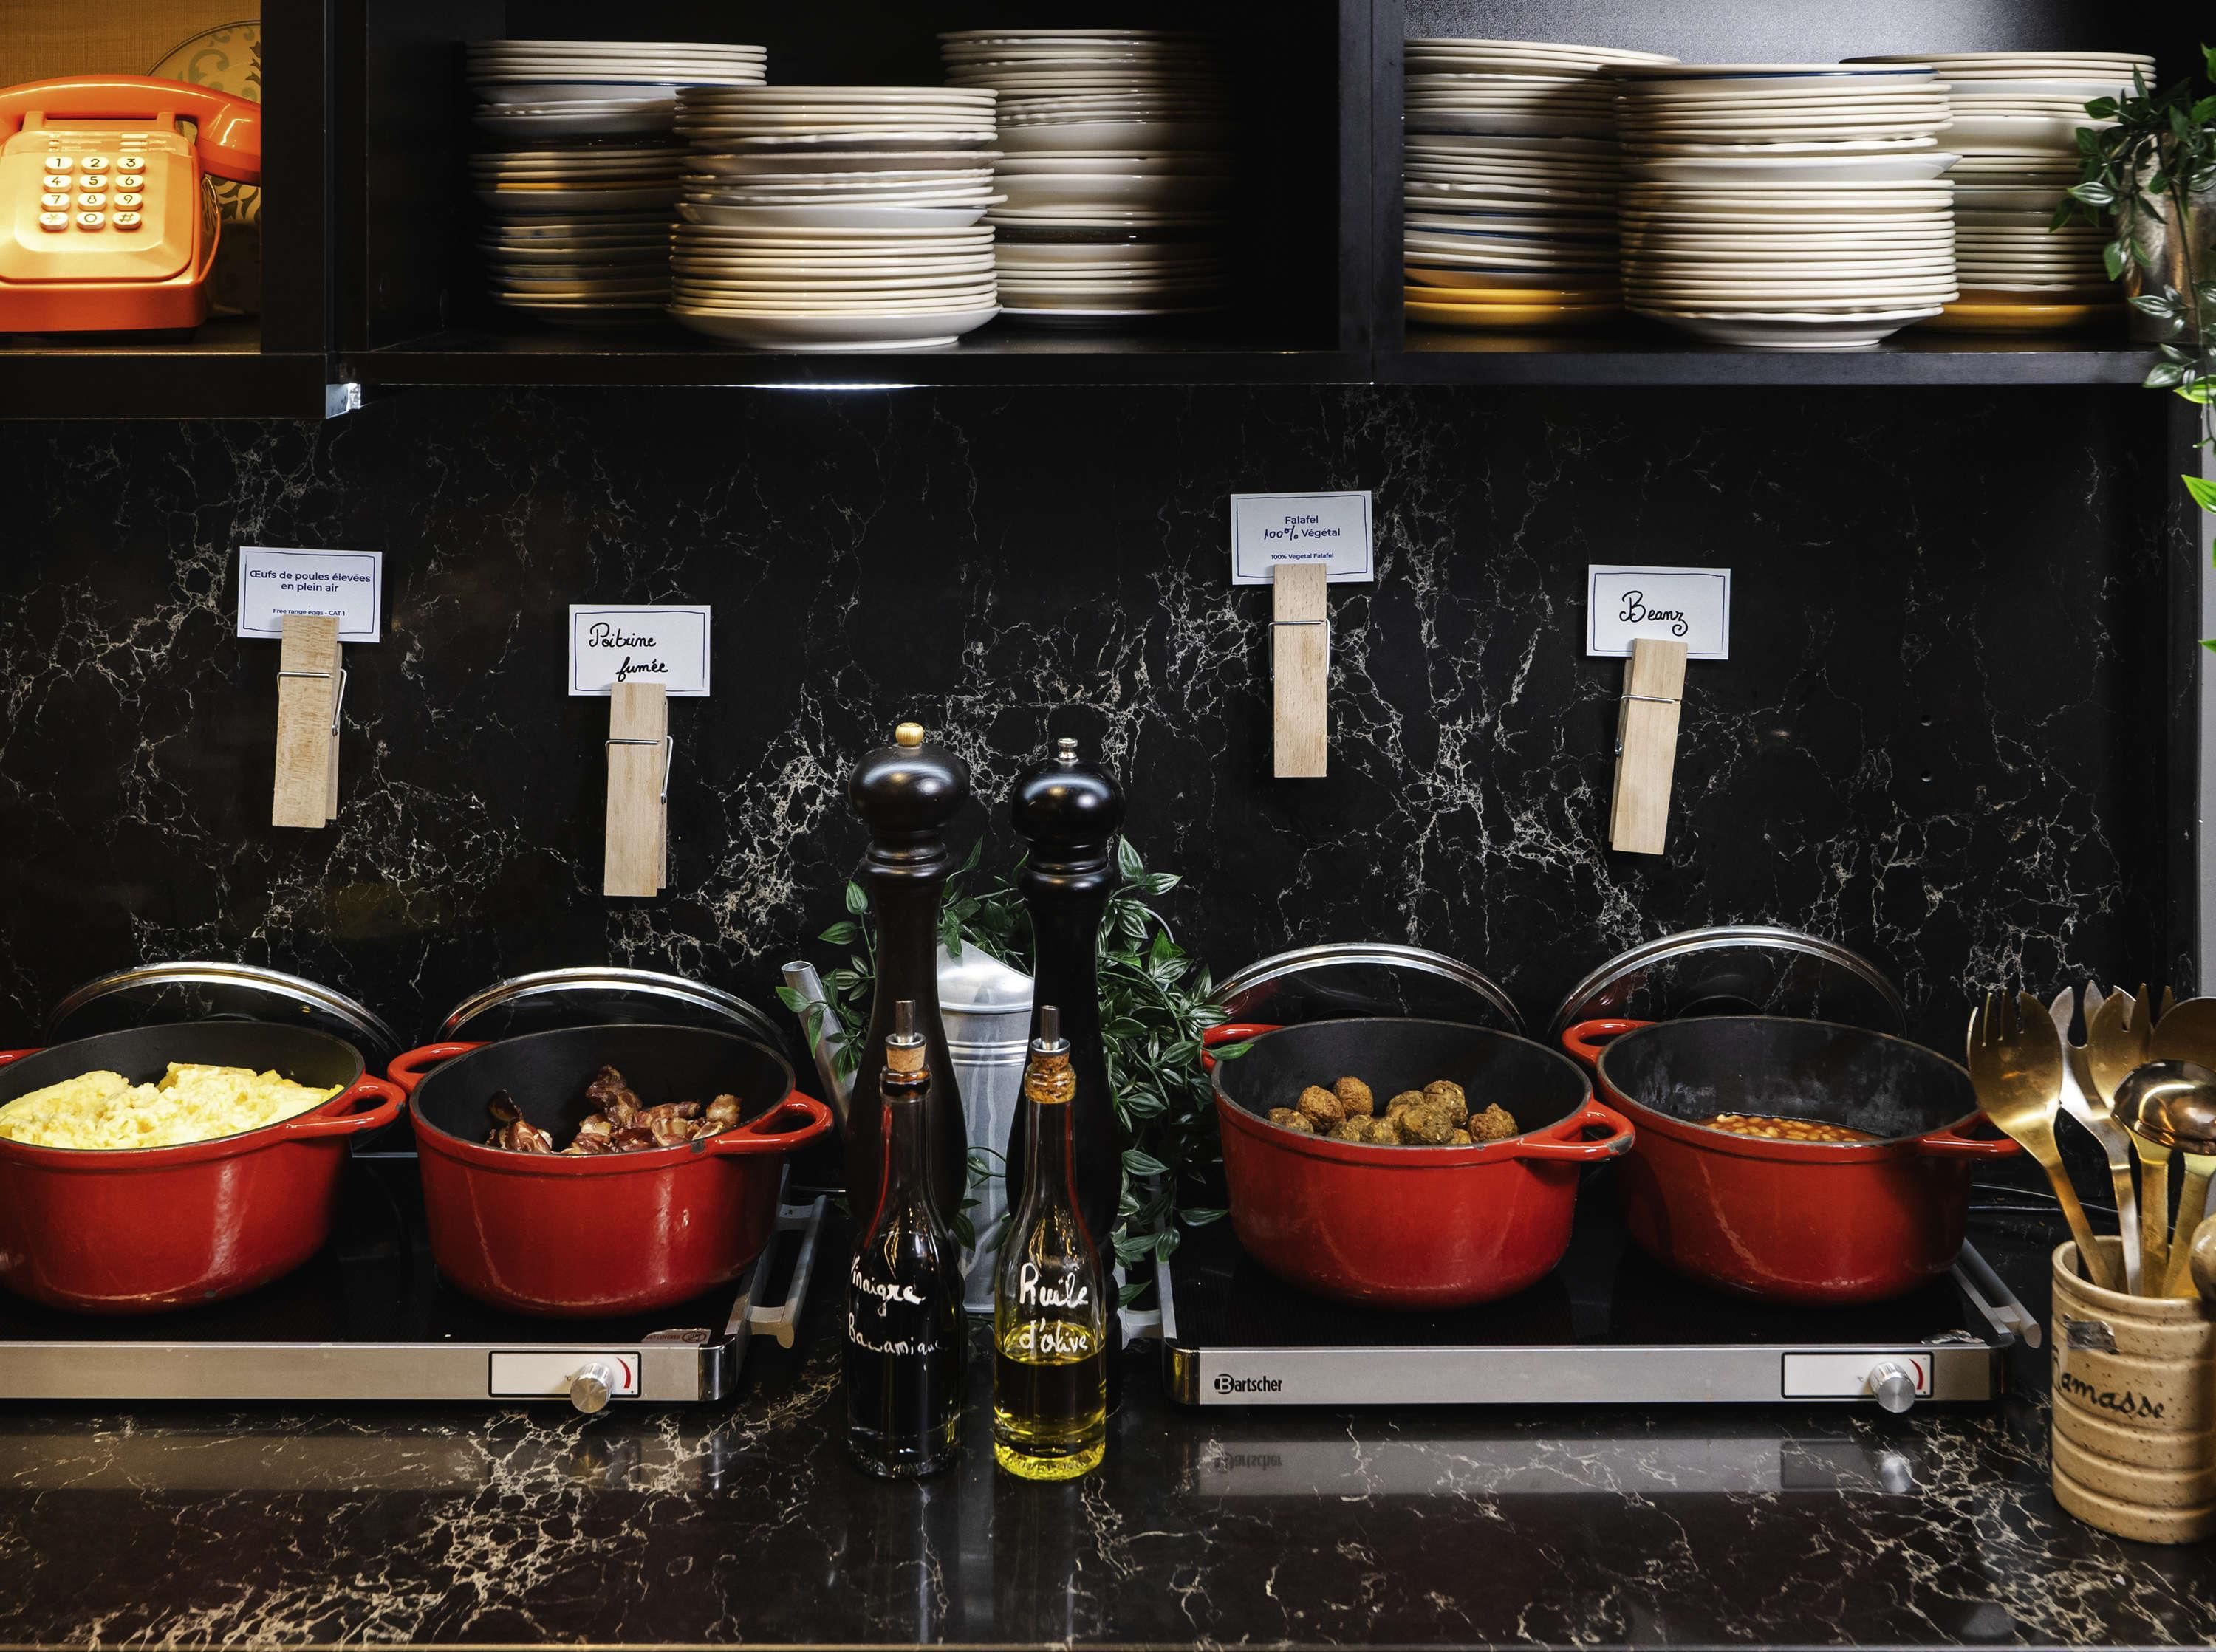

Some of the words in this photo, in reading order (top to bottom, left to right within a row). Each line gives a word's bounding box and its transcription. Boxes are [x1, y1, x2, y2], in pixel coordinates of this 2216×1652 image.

[56, 158, 61, 167] 1
[90, 158, 100, 168] 2
[126, 158, 136, 168] 3
[51, 176, 61, 185] 4
[89, 176, 98, 185] 5
[125, 176, 134, 185] 6
[52, 195, 61, 204] 7
[87, 195, 97, 204] 8
[124, 195, 133, 204] 9
[1285, 515, 1319, 524] Falafel
[1264, 525, 1299, 541] 100%
[1302, 528, 1341, 538] Végétal
[250, 570, 277, 579] Œufs
[279, 571, 293, 580] de
[295, 572, 329, 581] poules
[332, 573, 371, 583] élevées
[297, 583, 322, 592] plein
[325, 583, 339, 592] air
[1619, 590, 1689, 637] Beanz
[589, 622, 656, 648] Poitrine
[615, 656, 668, 682] fumée
[1019, 1317, 1088, 1353] d'olive
[1214, 1373, 1282, 1394] Bartscher
